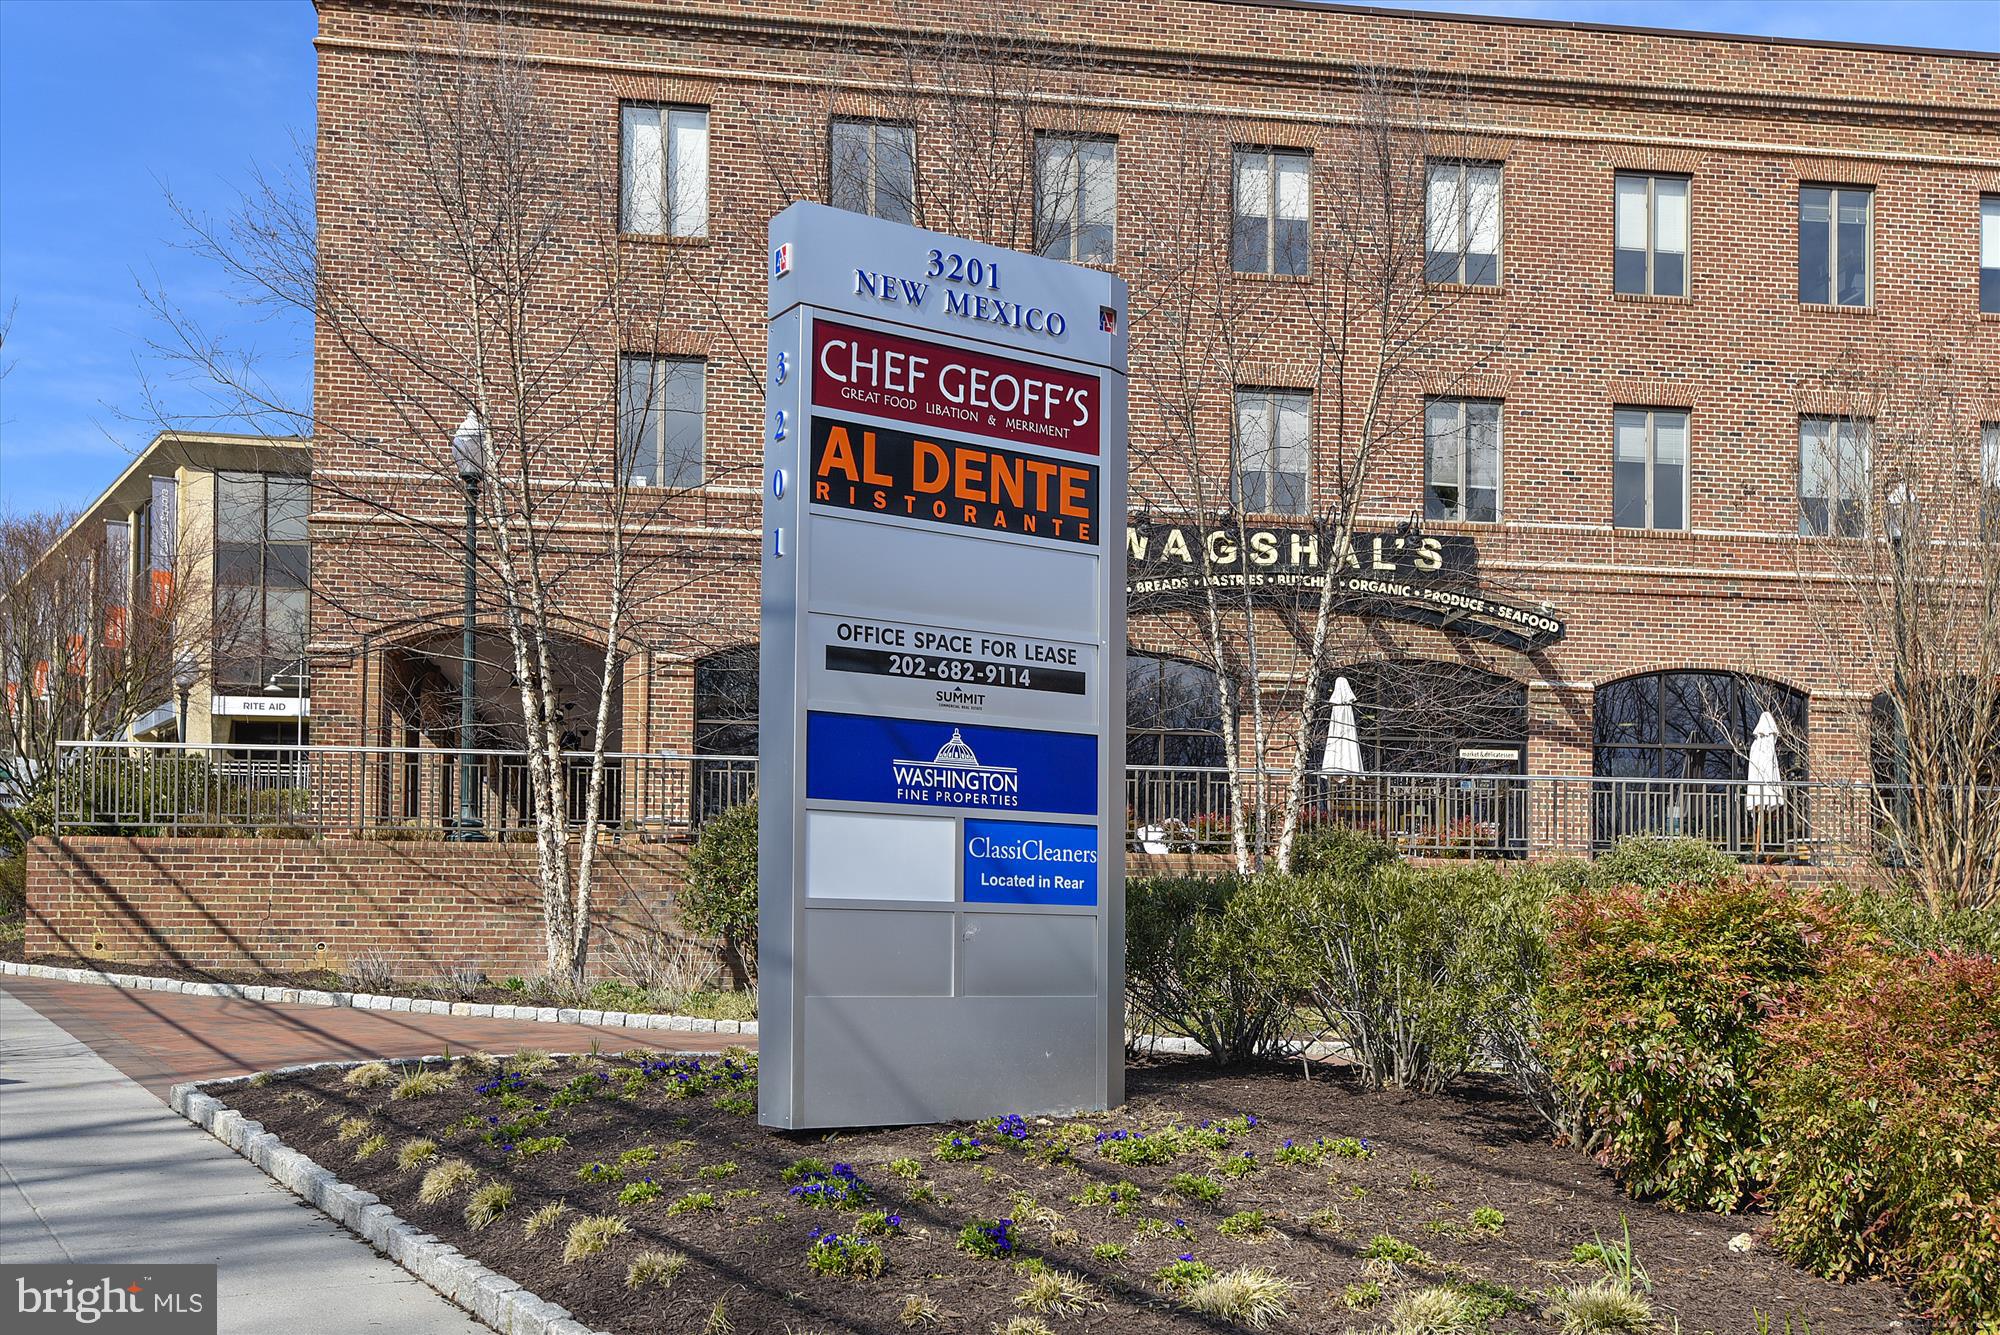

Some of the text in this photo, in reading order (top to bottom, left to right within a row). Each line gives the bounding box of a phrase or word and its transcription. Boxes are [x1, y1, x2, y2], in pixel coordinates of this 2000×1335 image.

[927, 249, 1001, 290] 3201
[855, 268, 1067, 337] NEW MEXICO
[820, 339, 1089, 427] CHEF GEOFF'S
[841, 386, 1071, 439] GREAT FOOD LIBATION & MERRIMENT
[817, 426, 1090, 519] AL DENTE
[816, 480, 1090, 541] RISTORANTE
[1136, 574, 1559, 633] BREADS ASTRES BUTCHE ORGANIC PRODUCE SEAFOOD
[836, 622, 1078, 666] OFFICE SPACE FOR LEASE
[888, 654, 1031, 687] 202-682-9114
[243, 702, 286, 711] RITE AID
[936, 690, 986, 705] SUMMIT
[893, 766, 1018, 793] WASHINGTON
[897, 788, 1018, 806] FINE PROPERTIES
[968, 836, 1098, 864] ClassiCleaners
[981, 872, 1085, 890] Located in Rear
